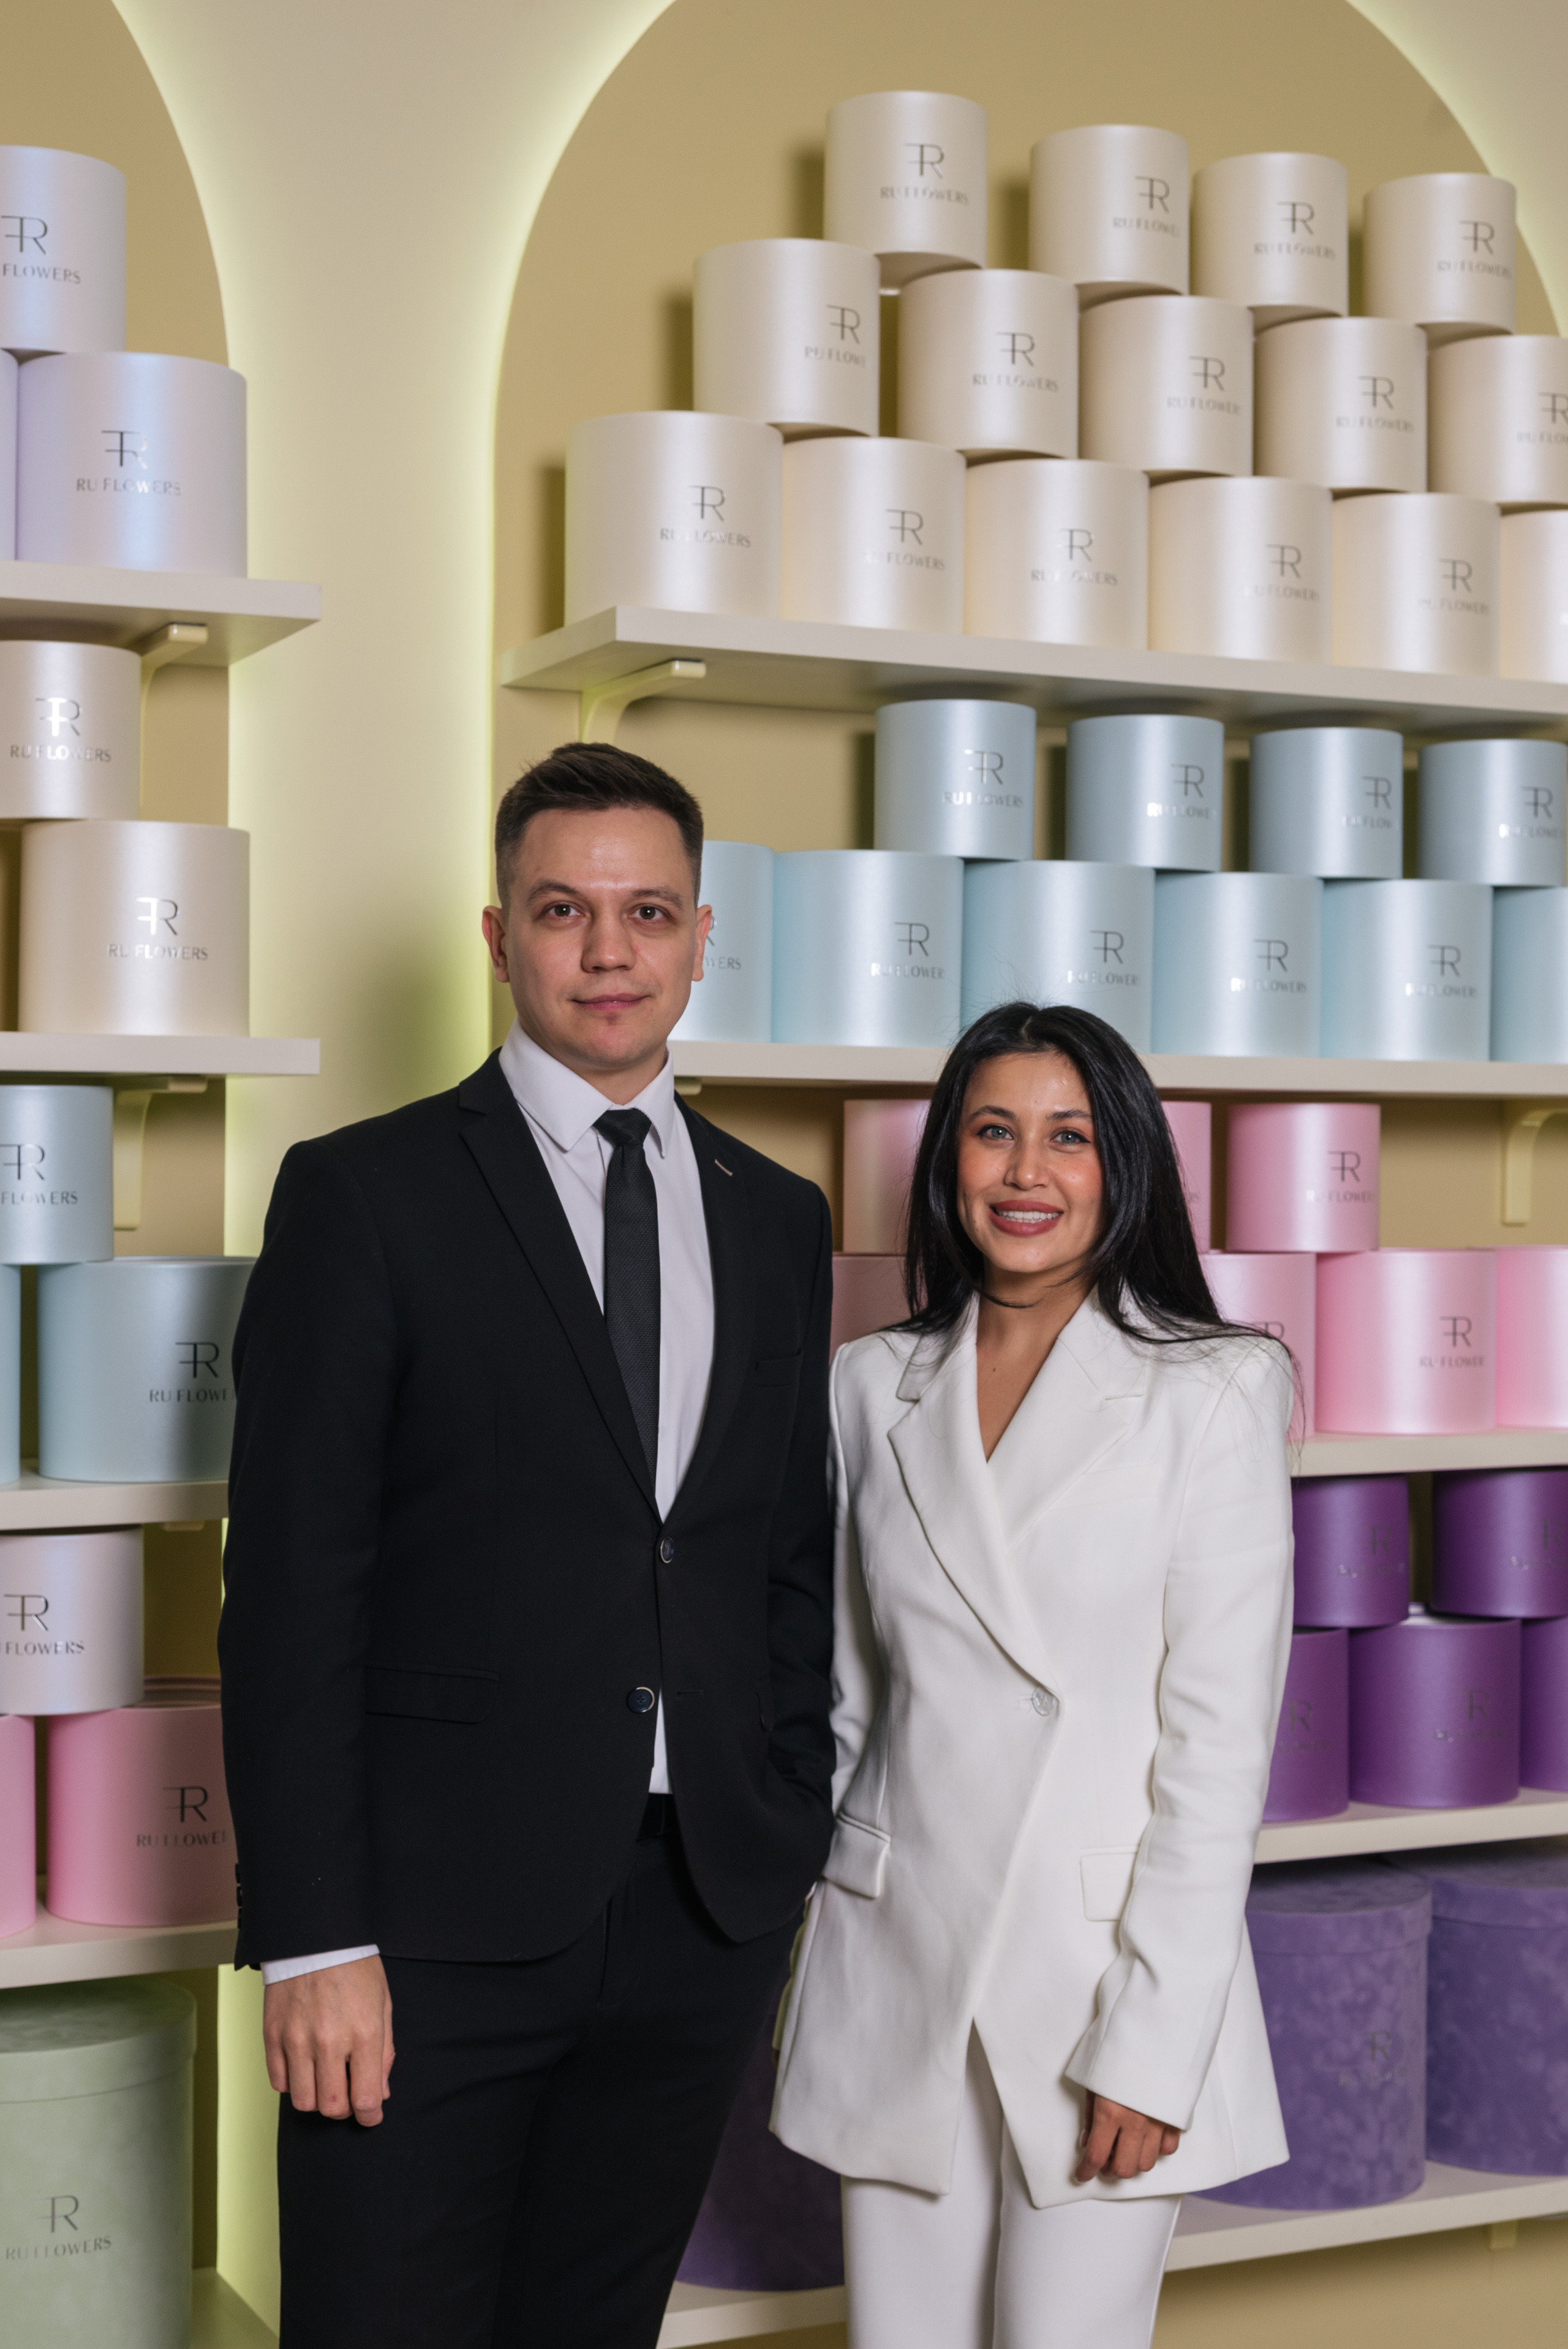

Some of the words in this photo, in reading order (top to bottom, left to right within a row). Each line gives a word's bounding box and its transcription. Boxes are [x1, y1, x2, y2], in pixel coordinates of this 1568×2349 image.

[2, 263, 81, 284] FLOWERS
[76, 477, 99, 492] RU
[102, 477, 182, 496] FLOWERS
[1054, 569, 1118, 587] FOWERS
[9, 744, 32, 759] RU
[35, 744, 112, 763] FLOWERS
[107, 943, 130, 958] RU
[135, 944, 209, 961] FLOWERS
[704, 956, 742, 970] WERS
[1, 1190, 78, 1205] FLOWERS
[149, 1388, 172, 1403] RU
[5, 1640, 85, 1657] FLOWERS
[6, 2247, 29, 2260] RU
